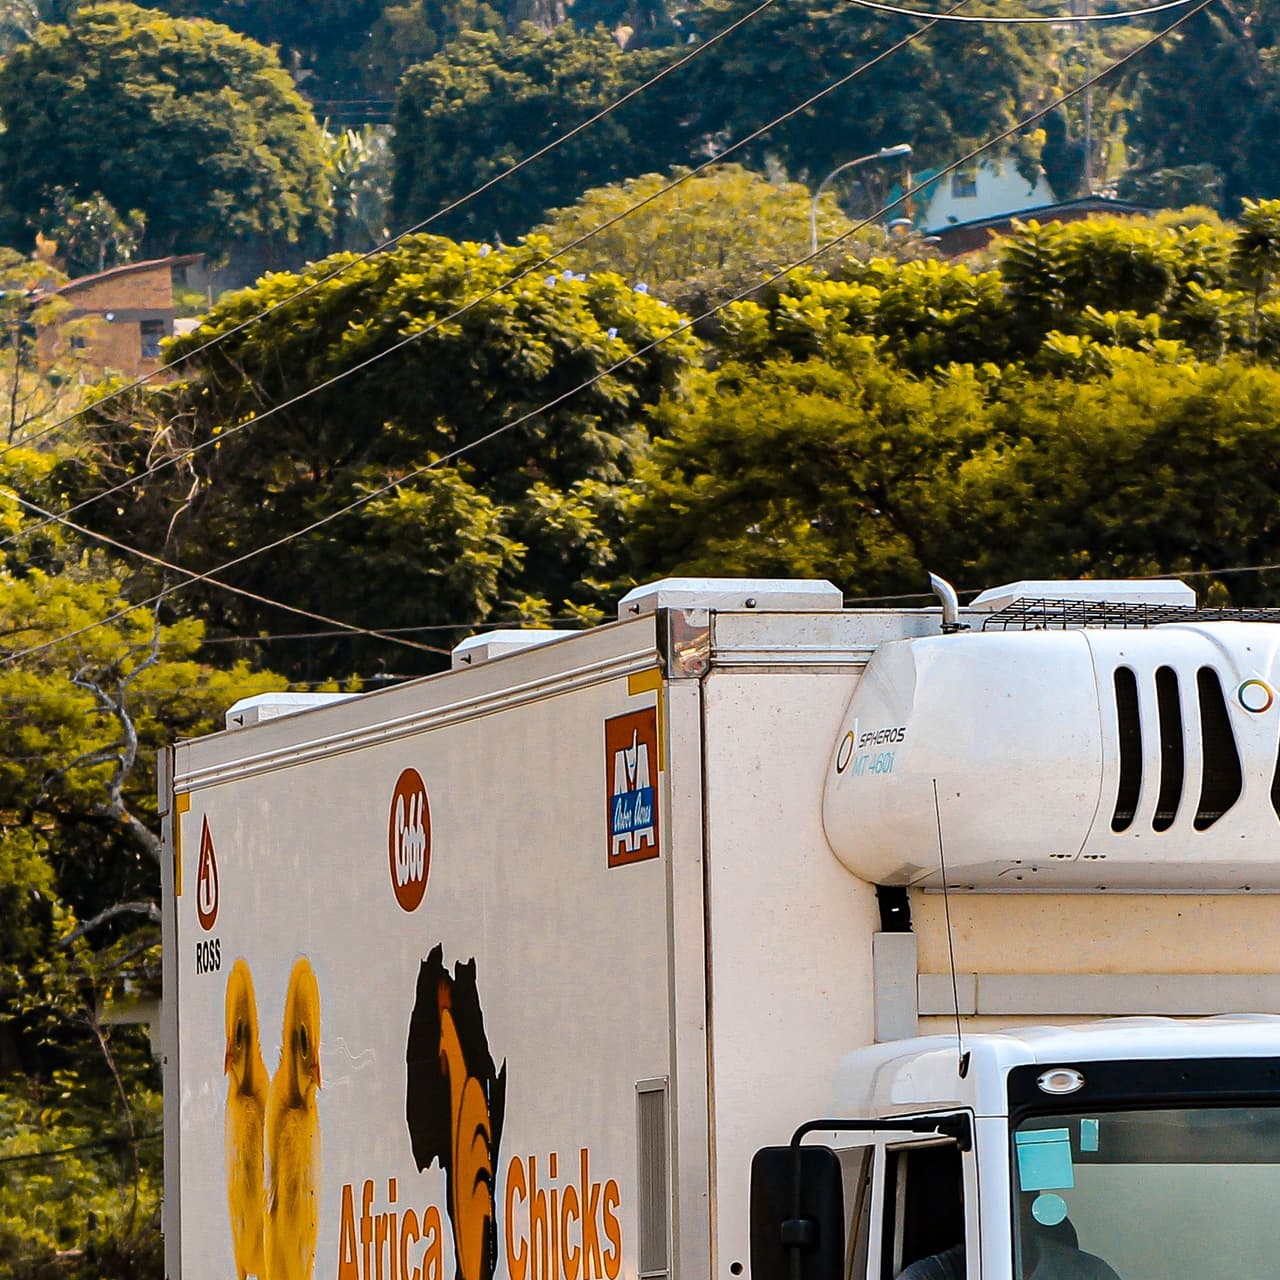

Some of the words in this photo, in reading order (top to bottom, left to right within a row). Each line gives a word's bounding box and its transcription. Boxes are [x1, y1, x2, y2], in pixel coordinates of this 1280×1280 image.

[859, 728, 906, 748] SPHEROS
[394, 790, 426, 887] Cobb
[196, 939, 221, 974] ROSS
